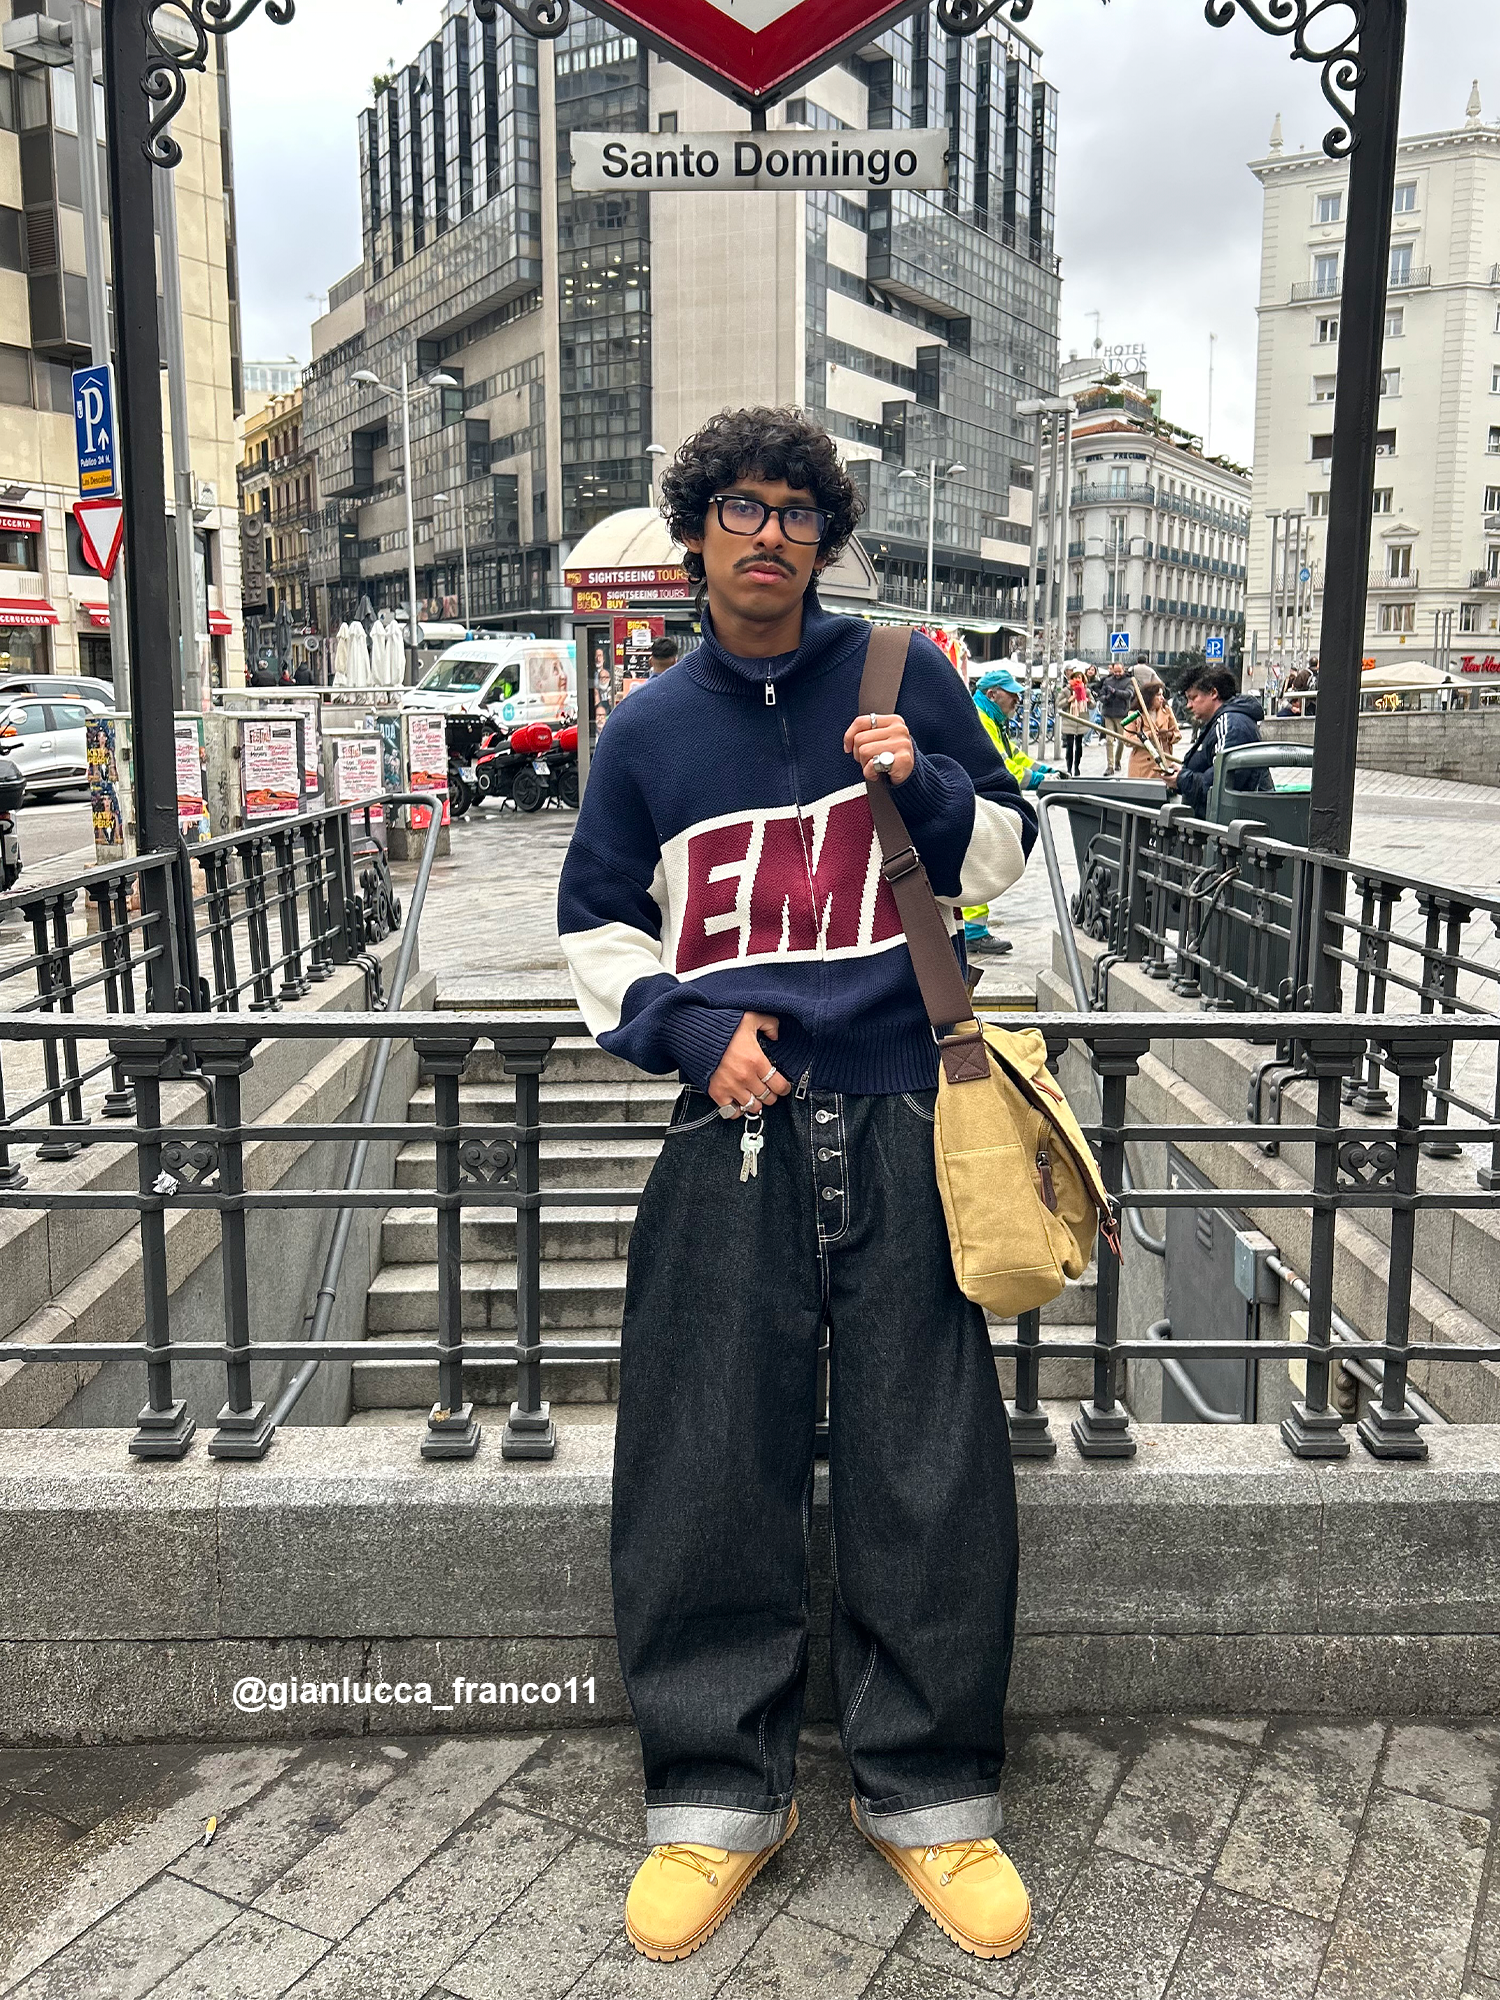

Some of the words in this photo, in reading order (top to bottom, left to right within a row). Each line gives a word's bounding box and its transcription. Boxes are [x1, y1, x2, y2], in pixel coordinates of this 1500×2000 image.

[602, 142, 720, 178] Santo
[734, 140, 918, 184] Domingo
[1103, 344, 1147, 357] HOTEL
[588, 570, 655, 584] SIGHTSEEING
[577, 592, 591, 602] BIG
[606, 590, 658, 600] SIGHTSEEING
[659, 589, 685, 598] TOURS
[606, 600, 623, 609] BUY
